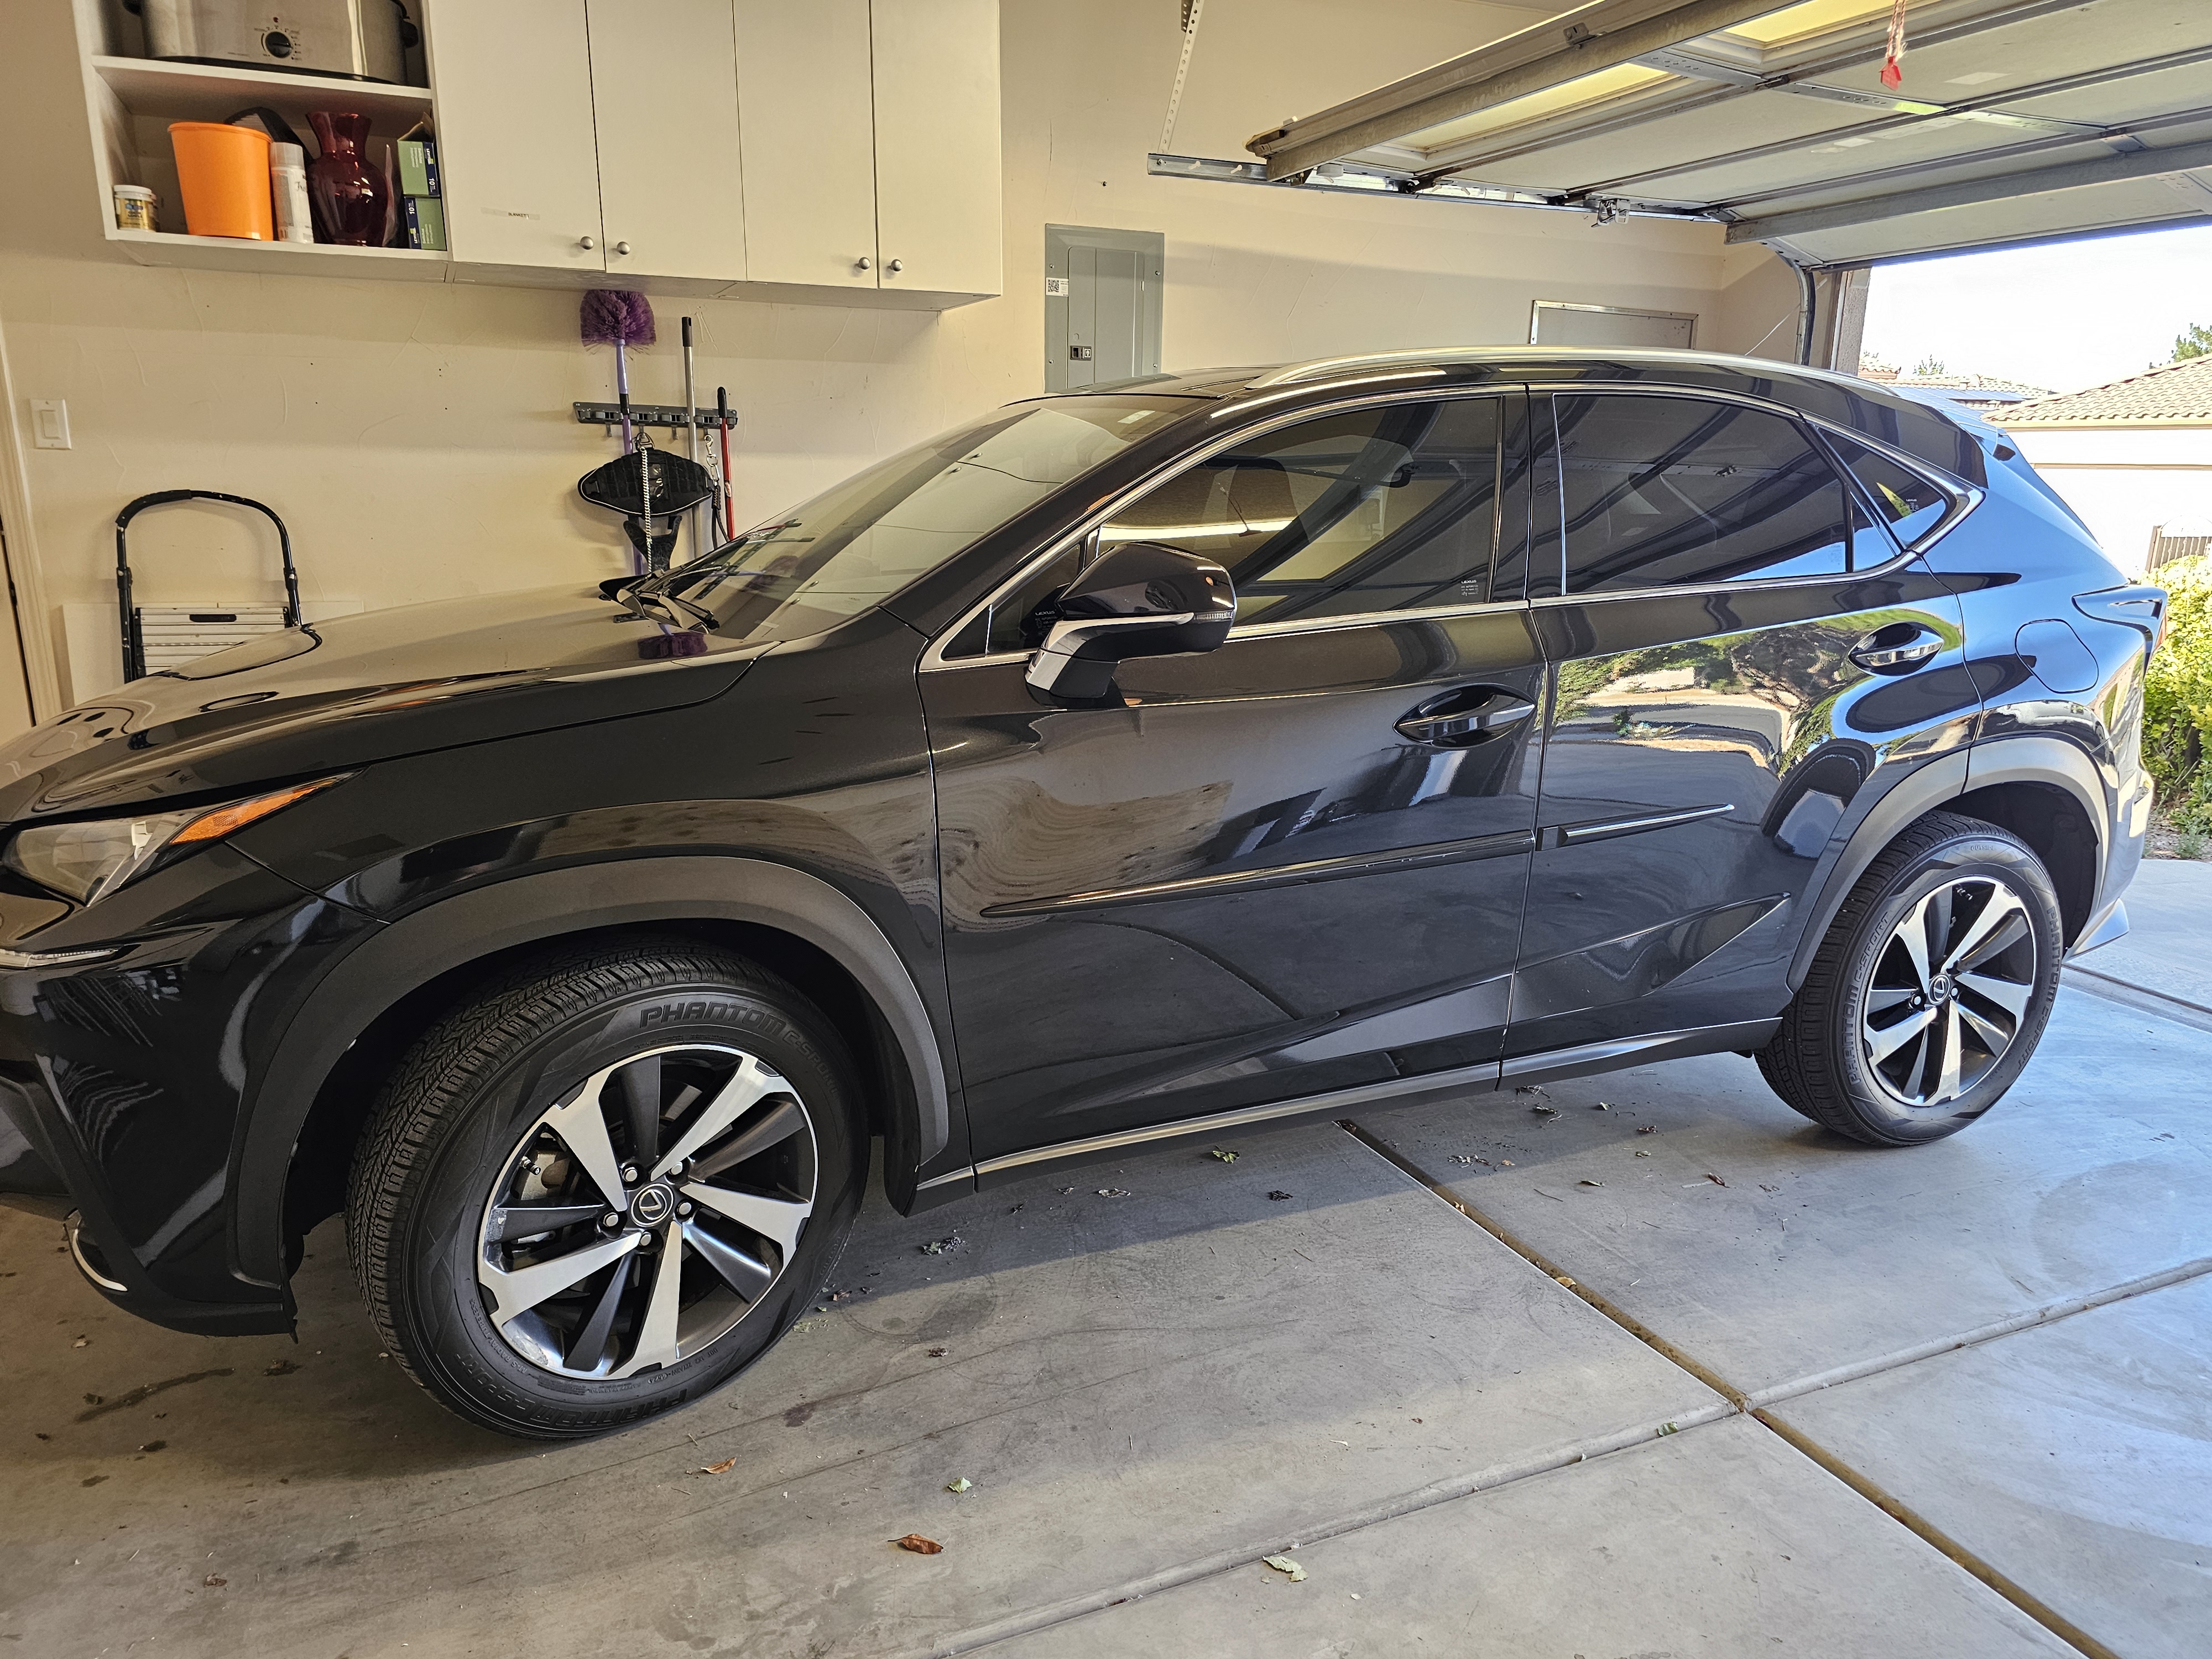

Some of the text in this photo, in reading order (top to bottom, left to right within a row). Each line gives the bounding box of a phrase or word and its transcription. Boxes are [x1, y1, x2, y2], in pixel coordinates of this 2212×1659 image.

[2046, 906, 2062, 1003] PHANTOM
[639, 1001, 786, 1036] PHANTOM
[1842, 984, 1861, 1086] PHANTOM
[530, 1389, 687, 1427] PHANTOM
